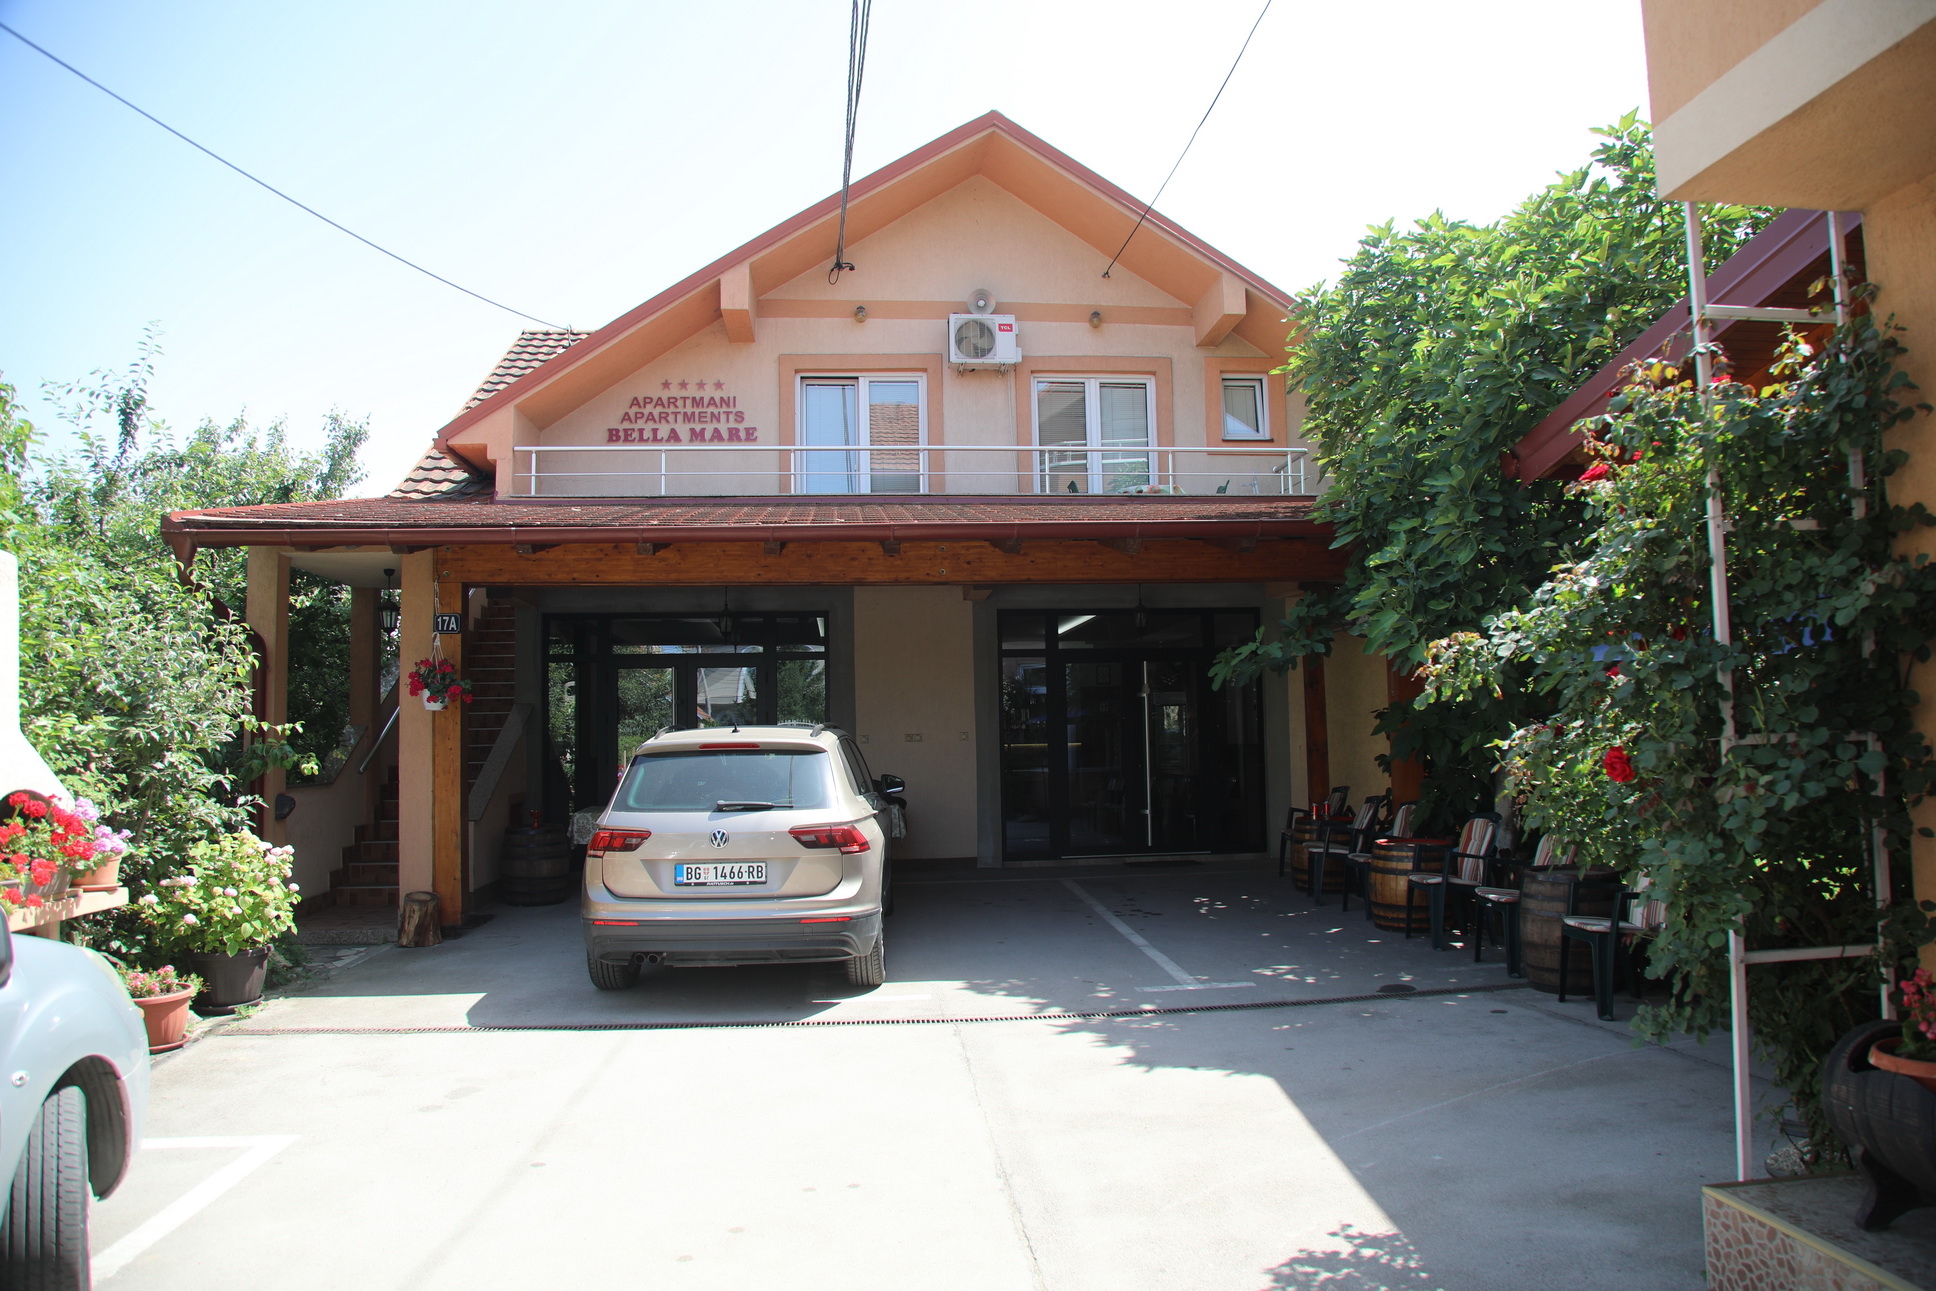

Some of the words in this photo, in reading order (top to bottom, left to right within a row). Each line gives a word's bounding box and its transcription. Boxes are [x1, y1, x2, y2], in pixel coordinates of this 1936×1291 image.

[629, 396, 737, 409] APARTMANI
[620, 411, 745, 424] APARTMENTS
[607, 427, 682, 443] BELLA
[689, 427, 758, 443] MARE
[437, 616, 457, 631] 17A
[686, 866, 702, 881] BG
